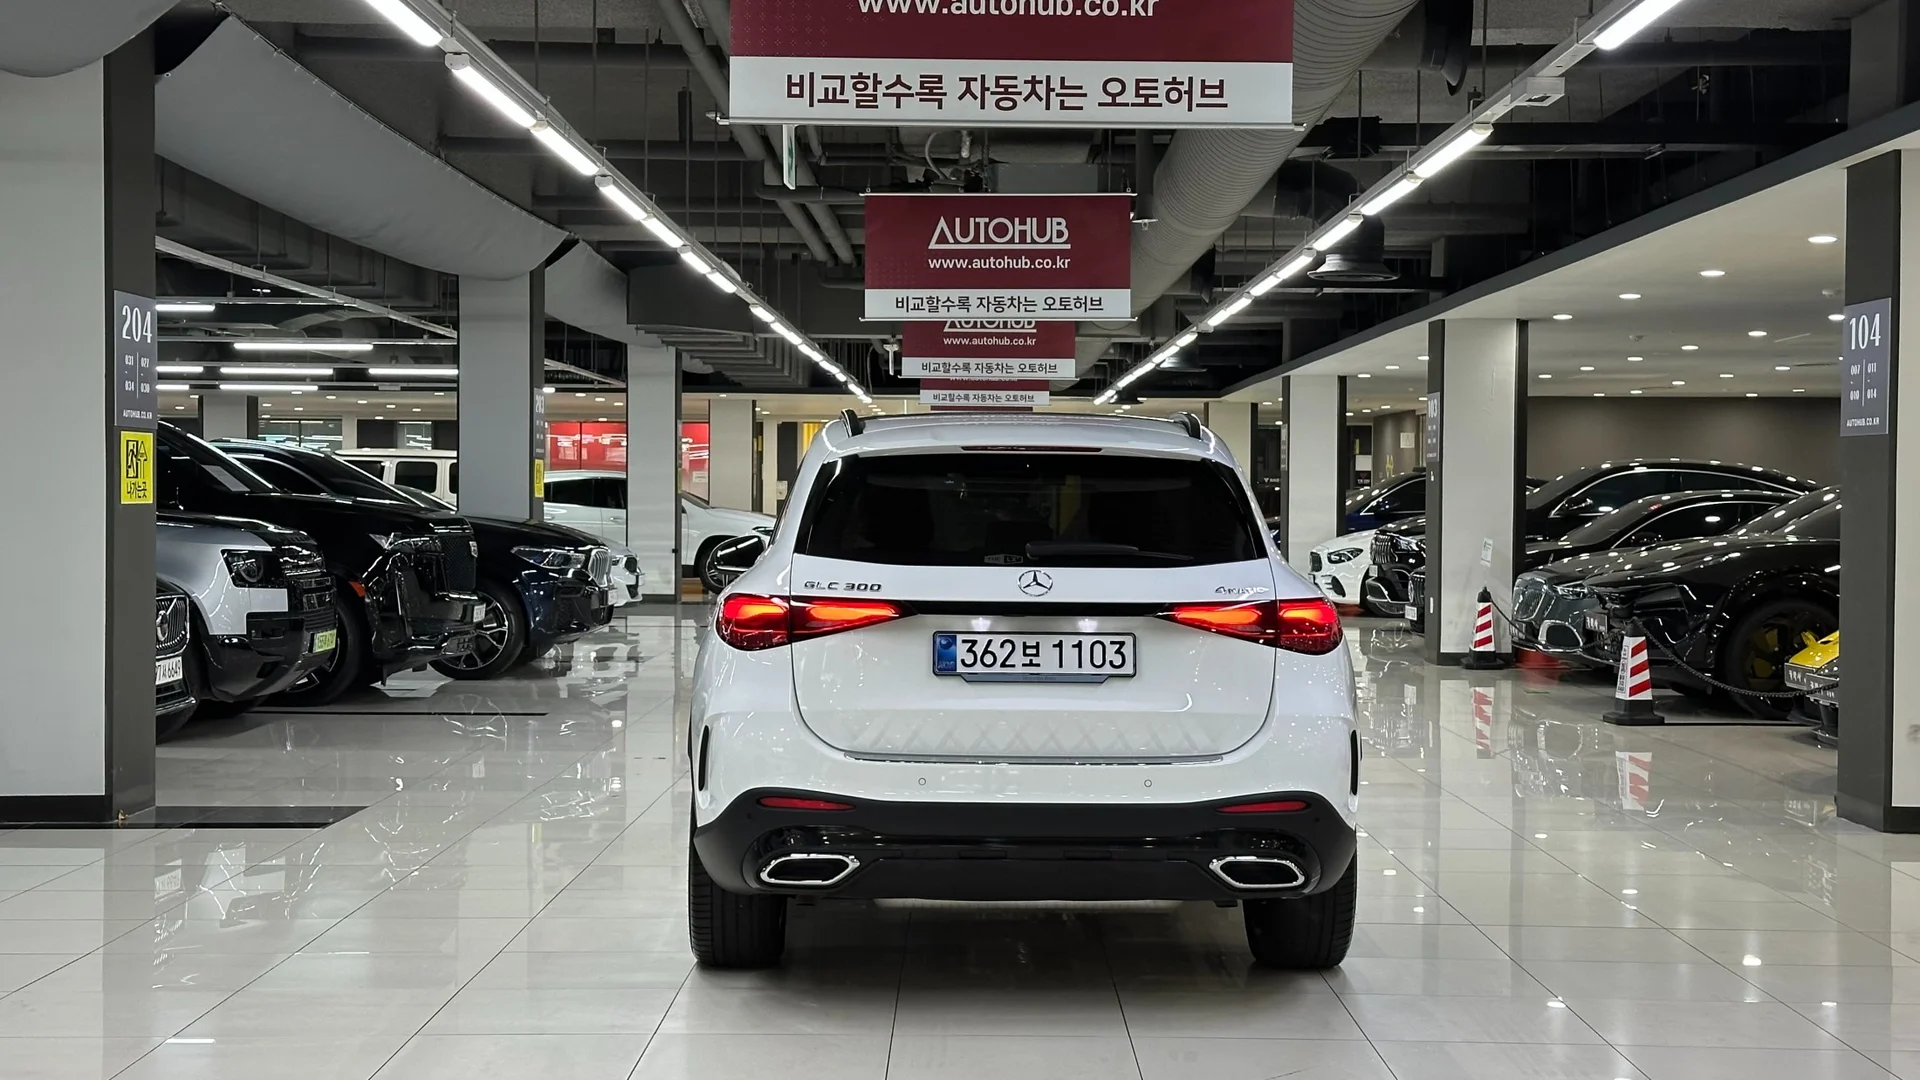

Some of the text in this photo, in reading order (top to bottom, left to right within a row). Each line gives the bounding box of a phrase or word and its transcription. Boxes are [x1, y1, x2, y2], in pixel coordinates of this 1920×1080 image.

[786, 71, 1228, 112] 비교할수록 자동차는 오토허브
[928, 216, 1071, 249] AUTOHUB
[928, 256, 1071, 269] www.autohub.co.kr
[895, 295, 1104, 314] 비교할수록 자동차는 오토허브
[122, 305, 152, 343] 204
[1849, 313, 1881, 350] 104
[943, 336, 1037, 346] www.autohub.co.kr
[921, 362, 1058, 374] 비교할수록 자동차는 오토허브
[1850, 364, 1861, 376] 007
[1866, 388, 1877, 400] 014
[122, 409, 153, 420] AUTOHUB.CO.KR
[1846, 416, 1880, 427] AUTOHUB.CO.KR
[126, 480, 147, 499] 나가는곳
[803, 580, 883, 593] GLC 300
[960, 638, 1127, 669] 362보 1103
